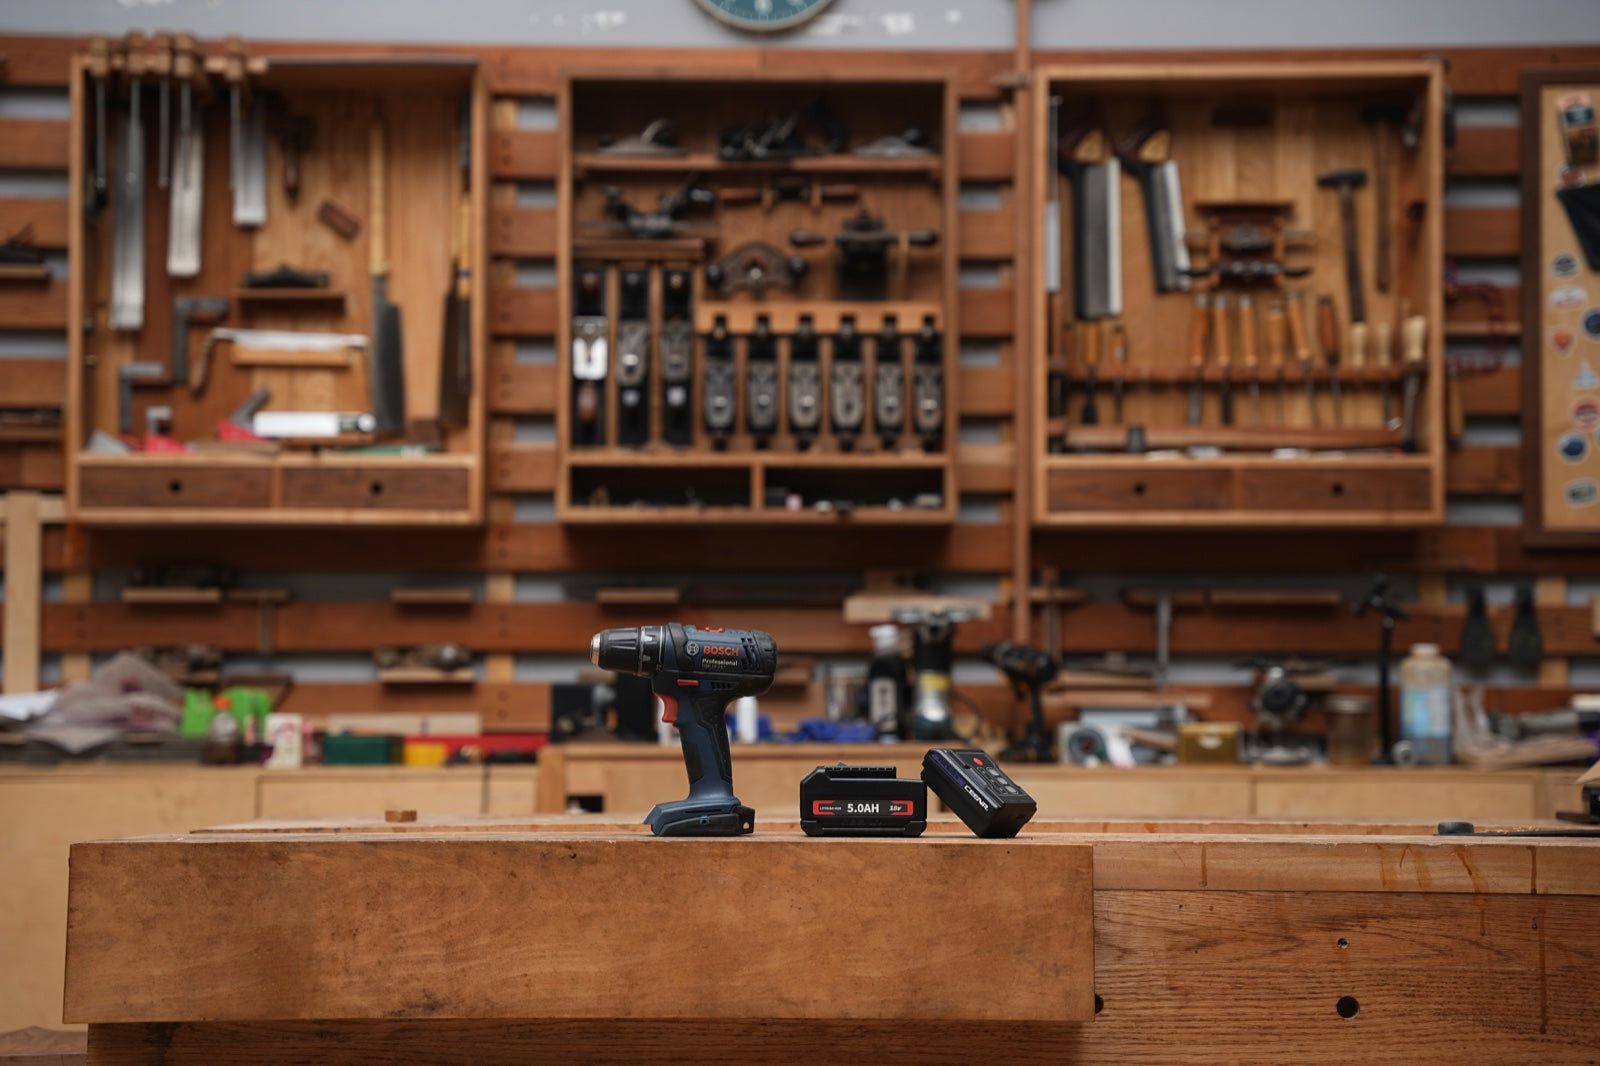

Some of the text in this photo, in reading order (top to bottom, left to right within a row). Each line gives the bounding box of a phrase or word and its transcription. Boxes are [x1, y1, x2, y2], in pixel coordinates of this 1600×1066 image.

[703, 645, 740, 657] BOSCH
[702, 658, 738, 667] Professional
[847, 803, 880, 813] 5.0AH
